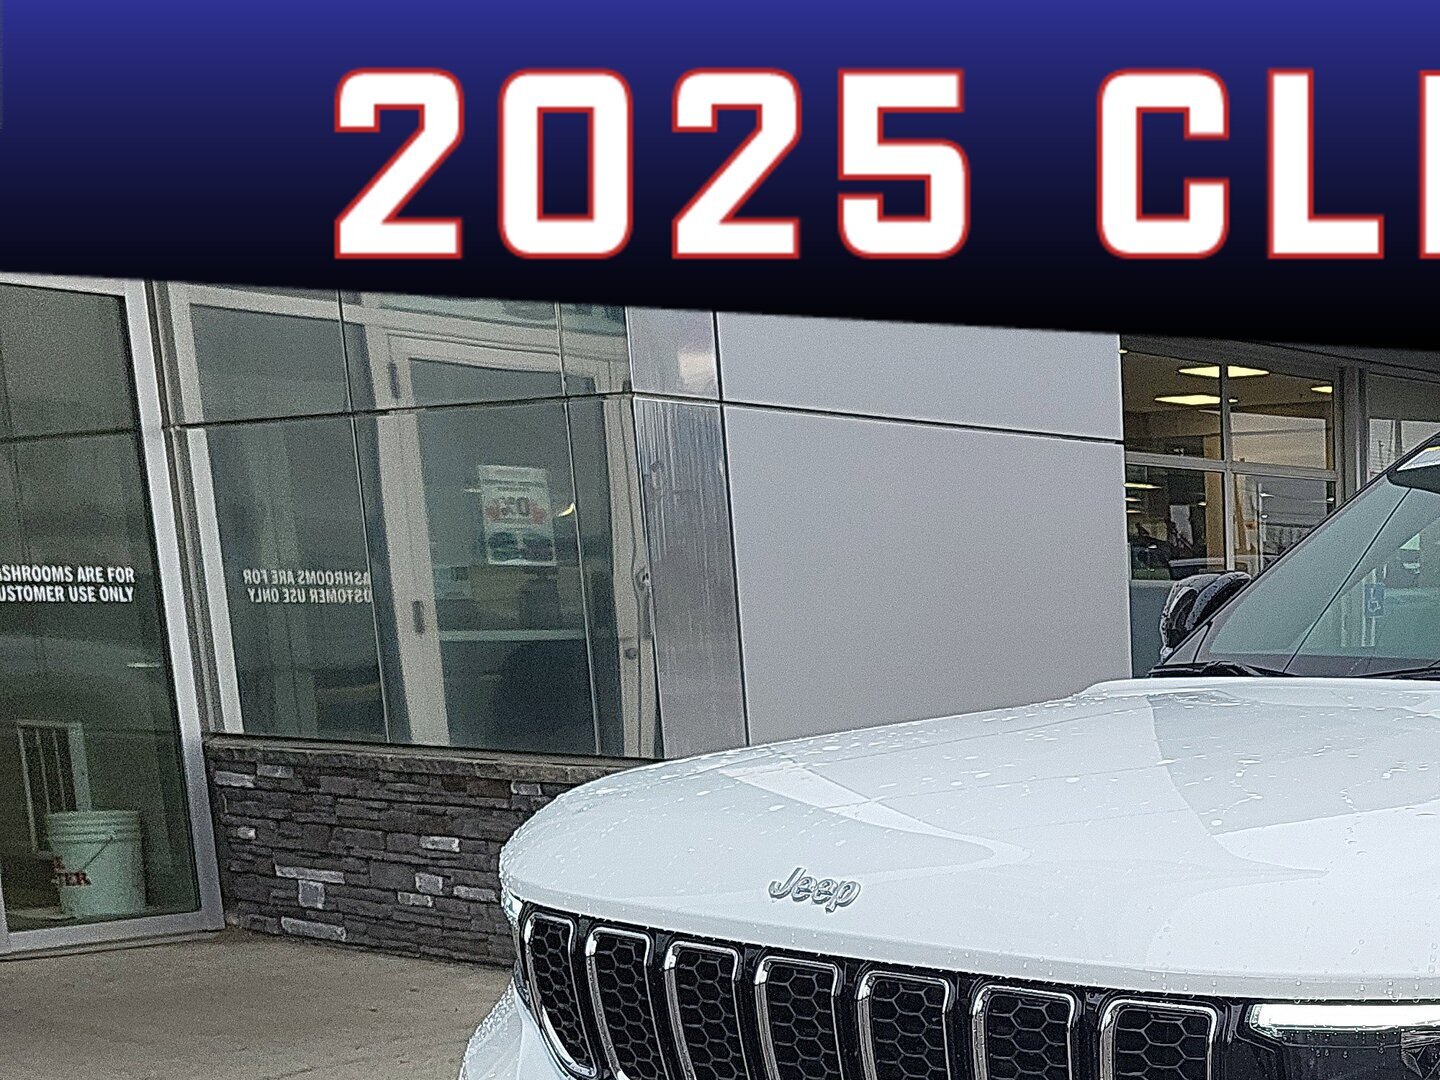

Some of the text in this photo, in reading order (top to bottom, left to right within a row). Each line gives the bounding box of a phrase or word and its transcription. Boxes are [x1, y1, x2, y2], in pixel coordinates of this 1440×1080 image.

[0, 564, 135, 583] SHROOMS ARE FOR
[67, 585, 97, 602] USE
[99, 585, 134, 602] ONLY
[767, 867, 862, 914] Jeep
